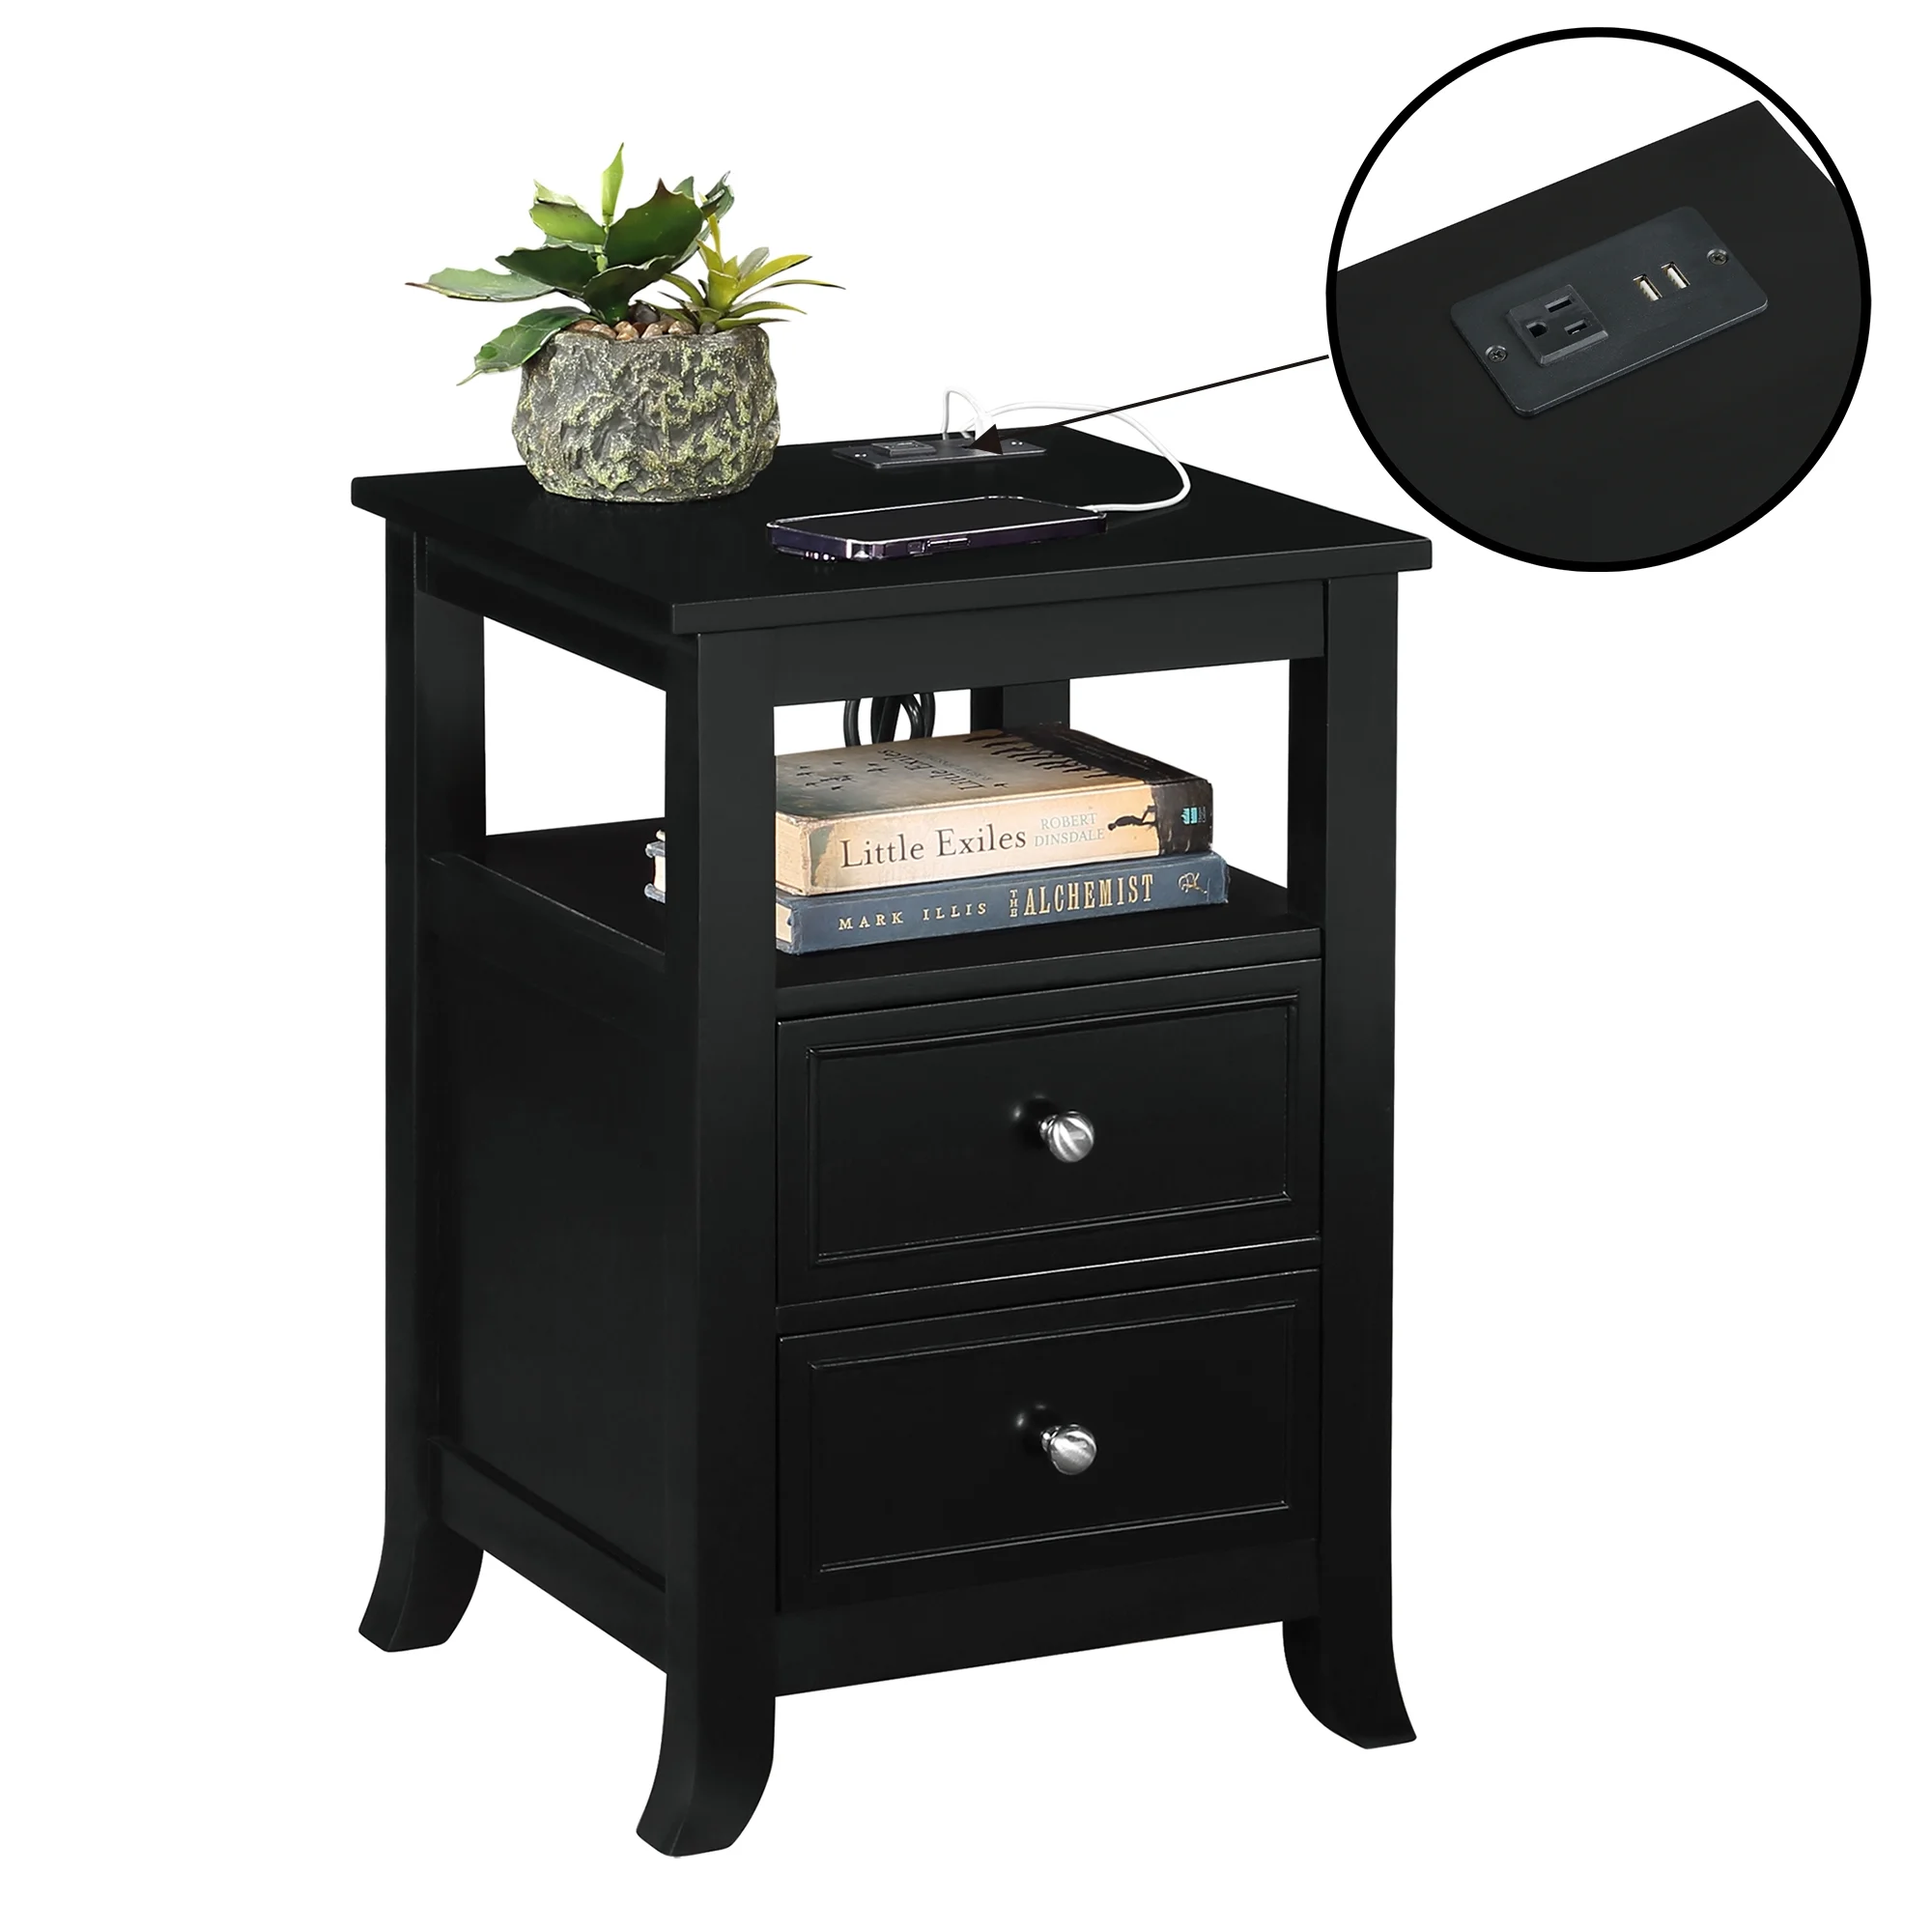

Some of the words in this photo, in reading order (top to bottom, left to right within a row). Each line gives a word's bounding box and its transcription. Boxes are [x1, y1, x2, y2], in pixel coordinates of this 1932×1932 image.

[1040, 812, 1097, 831] ROBERT
[839, 834, 924, 868] Little
[935, 823, 1026, 857] Exiles
[1035, 828, 1105, 847] DINSDALE
[1009, 889, 1018, 918] THE
[1024, 873, 1153, 916] ALCHEMIST
[838, 912, 903, 930] MARK
[923, 902, 986, 921] ILLIS
